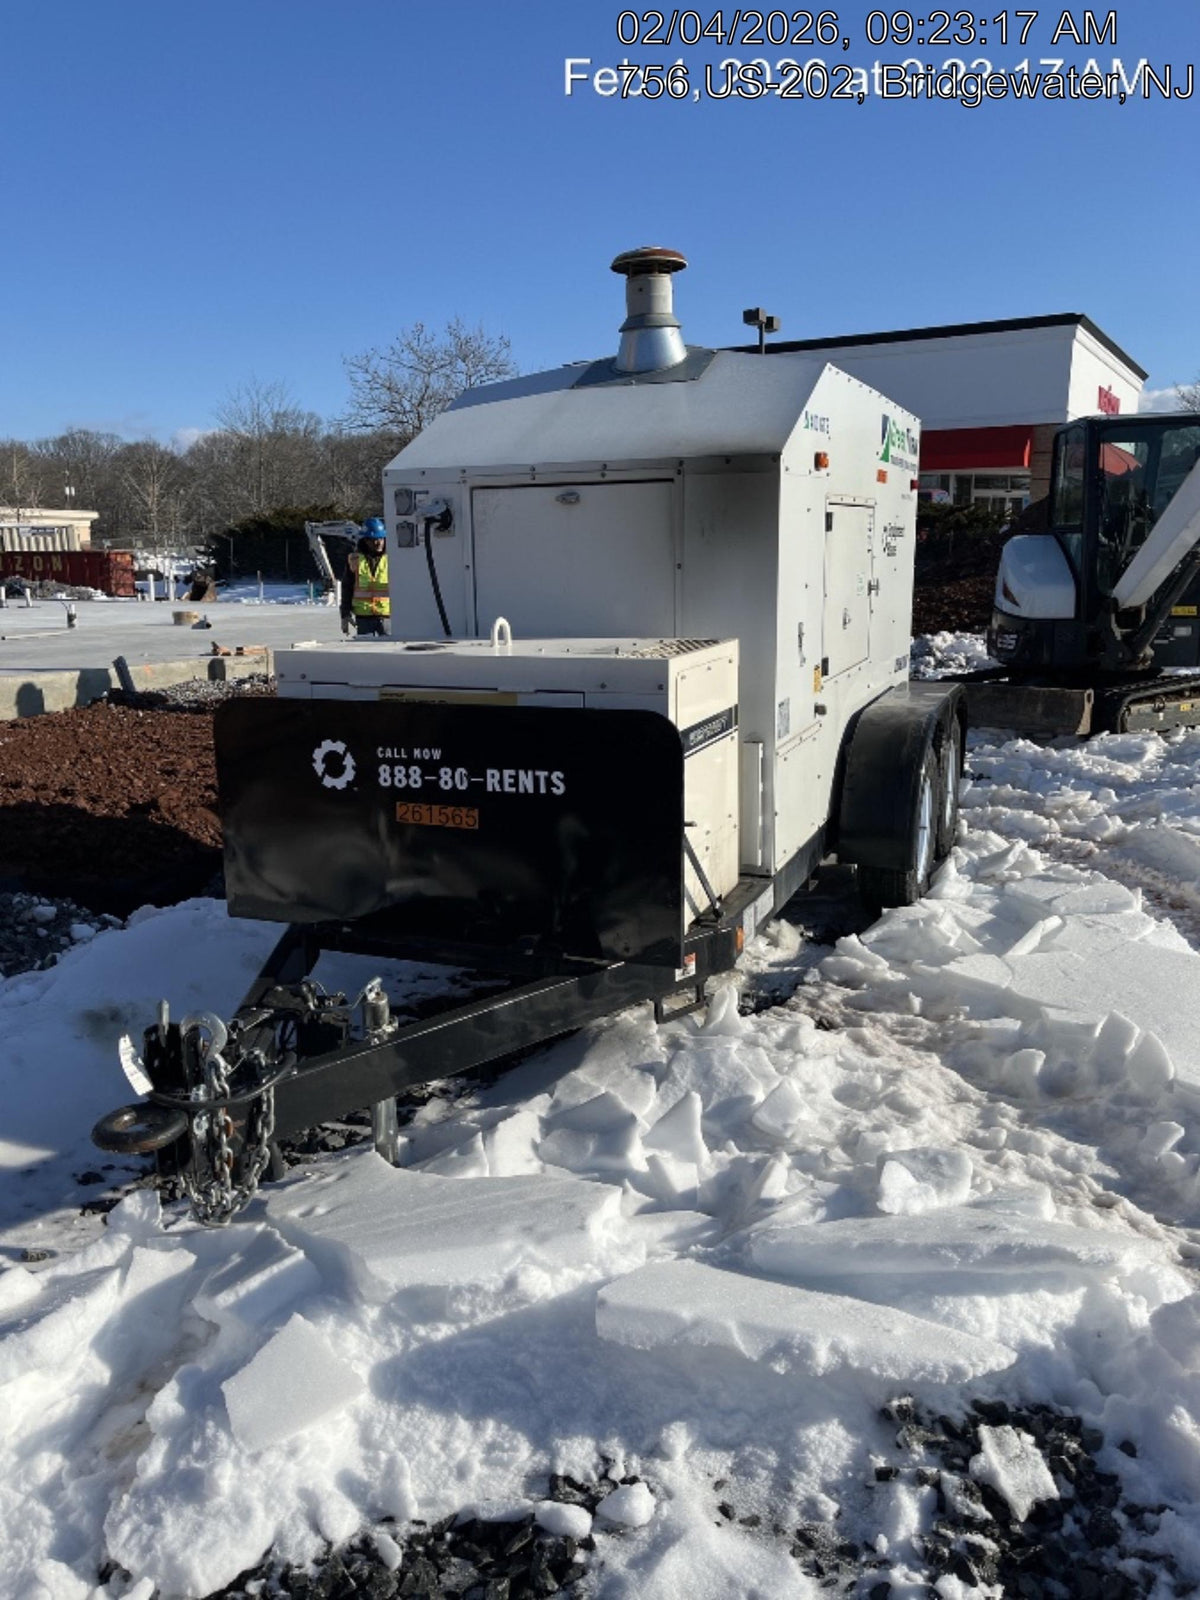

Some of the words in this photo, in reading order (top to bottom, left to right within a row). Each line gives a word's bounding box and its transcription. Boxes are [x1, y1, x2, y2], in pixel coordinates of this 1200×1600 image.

[377, 746, 408, 759] CALL
[413, 748, 442, 760] NOW
[398, 804, 477, 828] 261565
